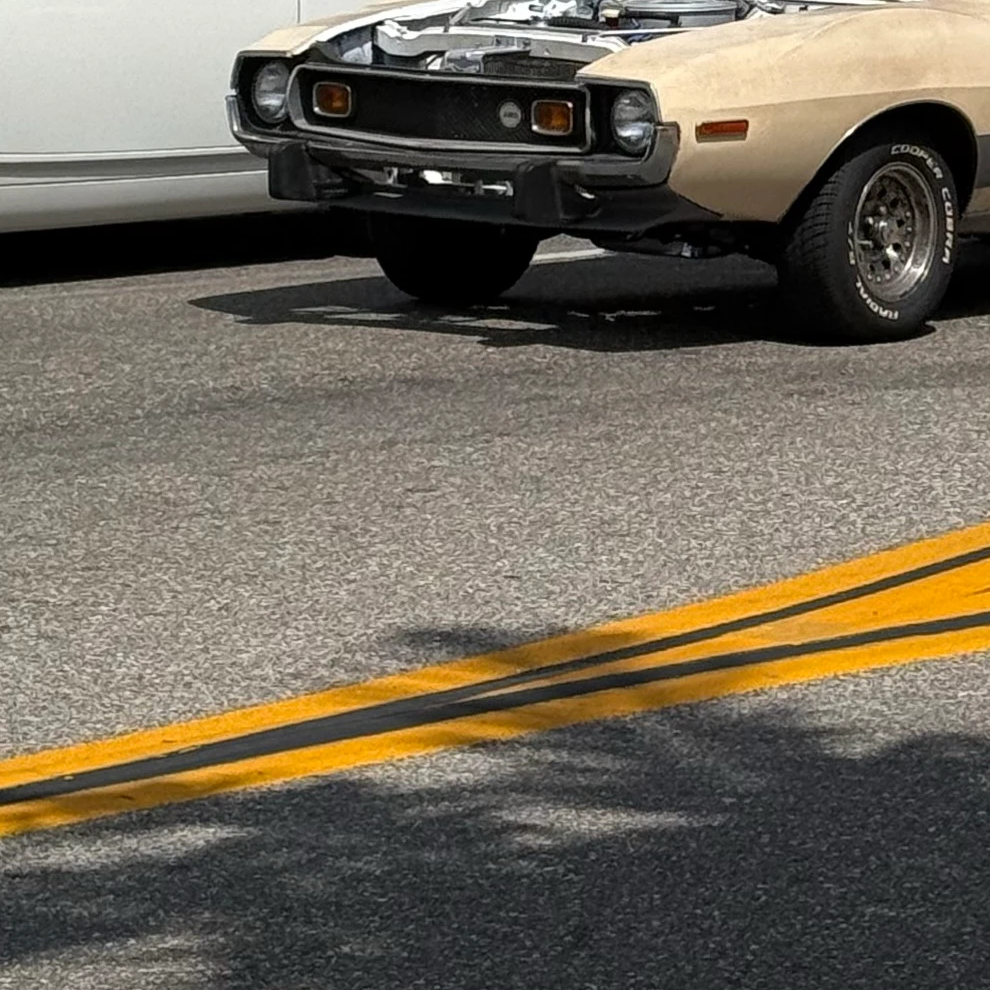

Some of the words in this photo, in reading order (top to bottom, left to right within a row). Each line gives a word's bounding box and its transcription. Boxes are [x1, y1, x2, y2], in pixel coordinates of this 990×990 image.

[890, 144, 943, 179] COOPER
[941, 187, 954, 264] COBRA
[855, 274, 899, 320] RADIAL
